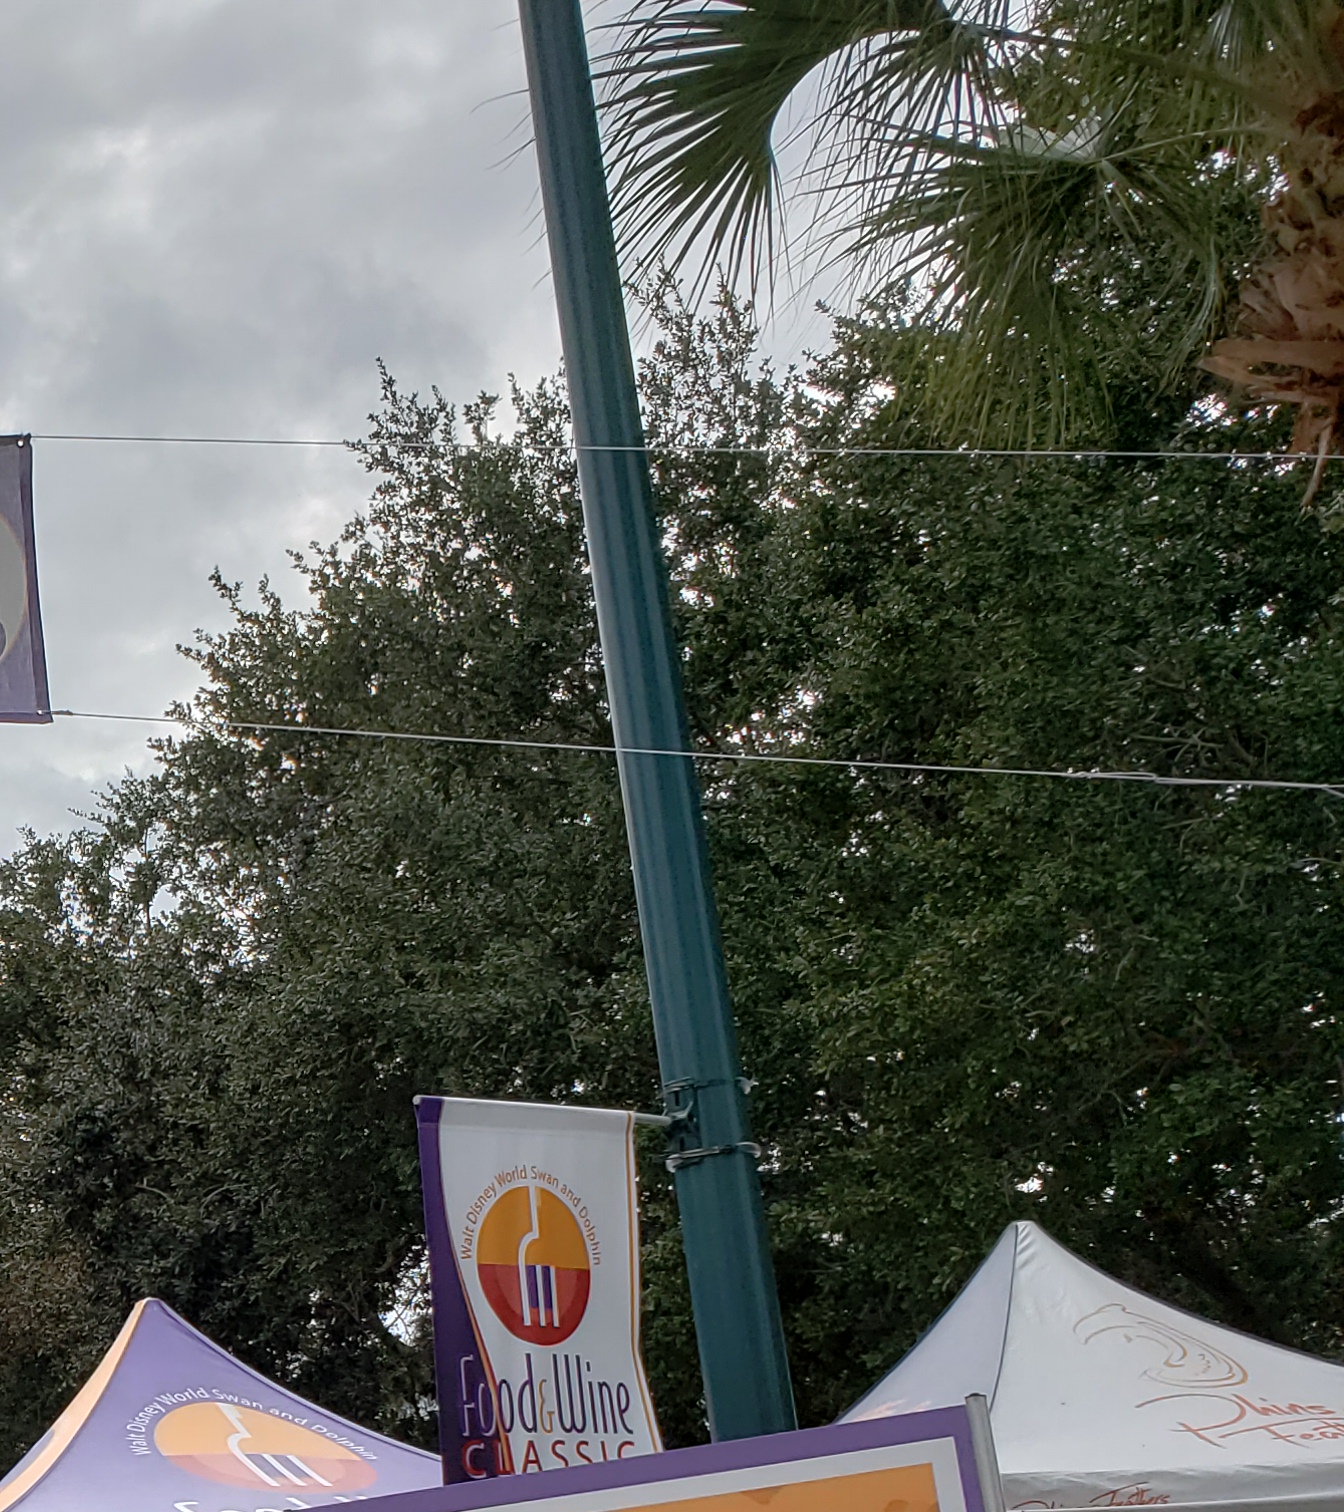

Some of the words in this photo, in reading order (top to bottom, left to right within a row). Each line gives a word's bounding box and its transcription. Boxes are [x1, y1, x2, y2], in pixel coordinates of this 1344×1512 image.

[494, 1164, 528, 1188] World
[530, 1165, 559, 1189] Swan
[466, 1182, 497, 1225] Disney
[560, 1183, 581, 1208] and
[461, 1225, 475, 1260] Walt
[578, 1205, 601, 1266] Dolphin
[154, 1386, 212, 1407] World
[211, 1387, 263, 1411] Swan
[126, 1396, 166, 1433] Disney
[269, 1407, 308, 1427] and
[125, 1434, 152, 1457] Walt
[310, 1423, 379, 1461] Dolphin
